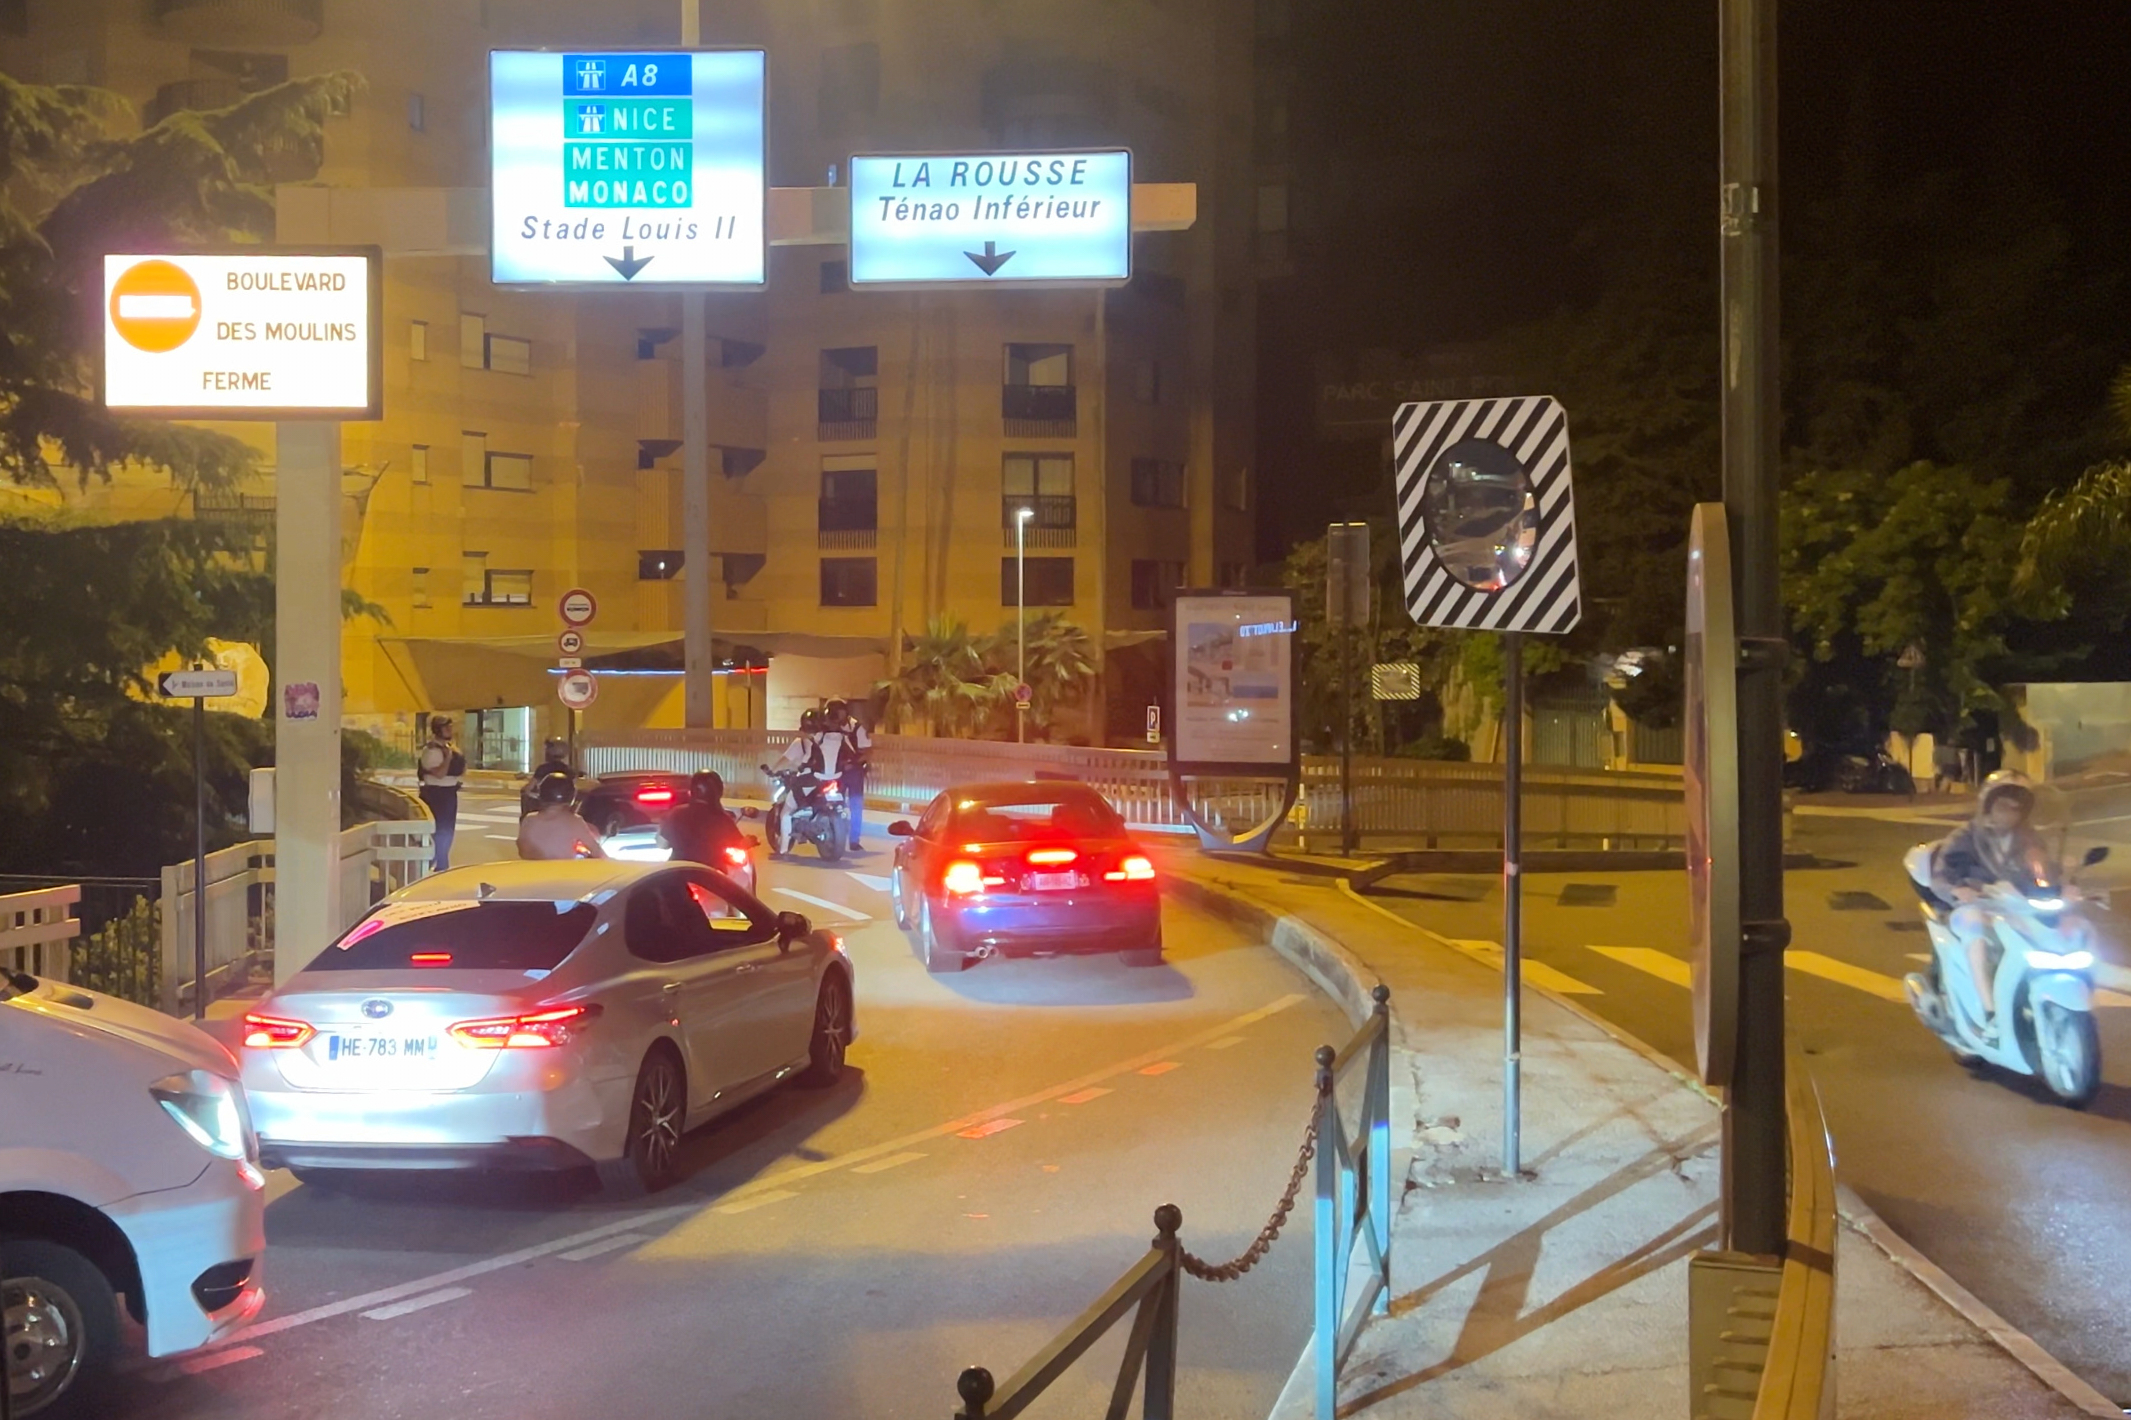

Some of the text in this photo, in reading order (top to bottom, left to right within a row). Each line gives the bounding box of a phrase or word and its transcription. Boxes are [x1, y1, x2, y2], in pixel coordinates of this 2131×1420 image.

[620, 64, 659, 87] A8
[613, 107, 676, 131] NICE
[572, 146, 685, 170] MENTON
[892, 159, 1088, 188] LA ROUSSE
[568, 180, 688, 204] MONACO
[878, 194, 1102, 222] Ténao Inférieur
[521, 215, 736, 241] Stade Louis II
[226, 272, 346, 292] BOULEVARD
[217, 322, 357, 342] DES MOULINS
[202, 371, 272, 391] FERME
[1322, 382, 1381, 401] PARC
